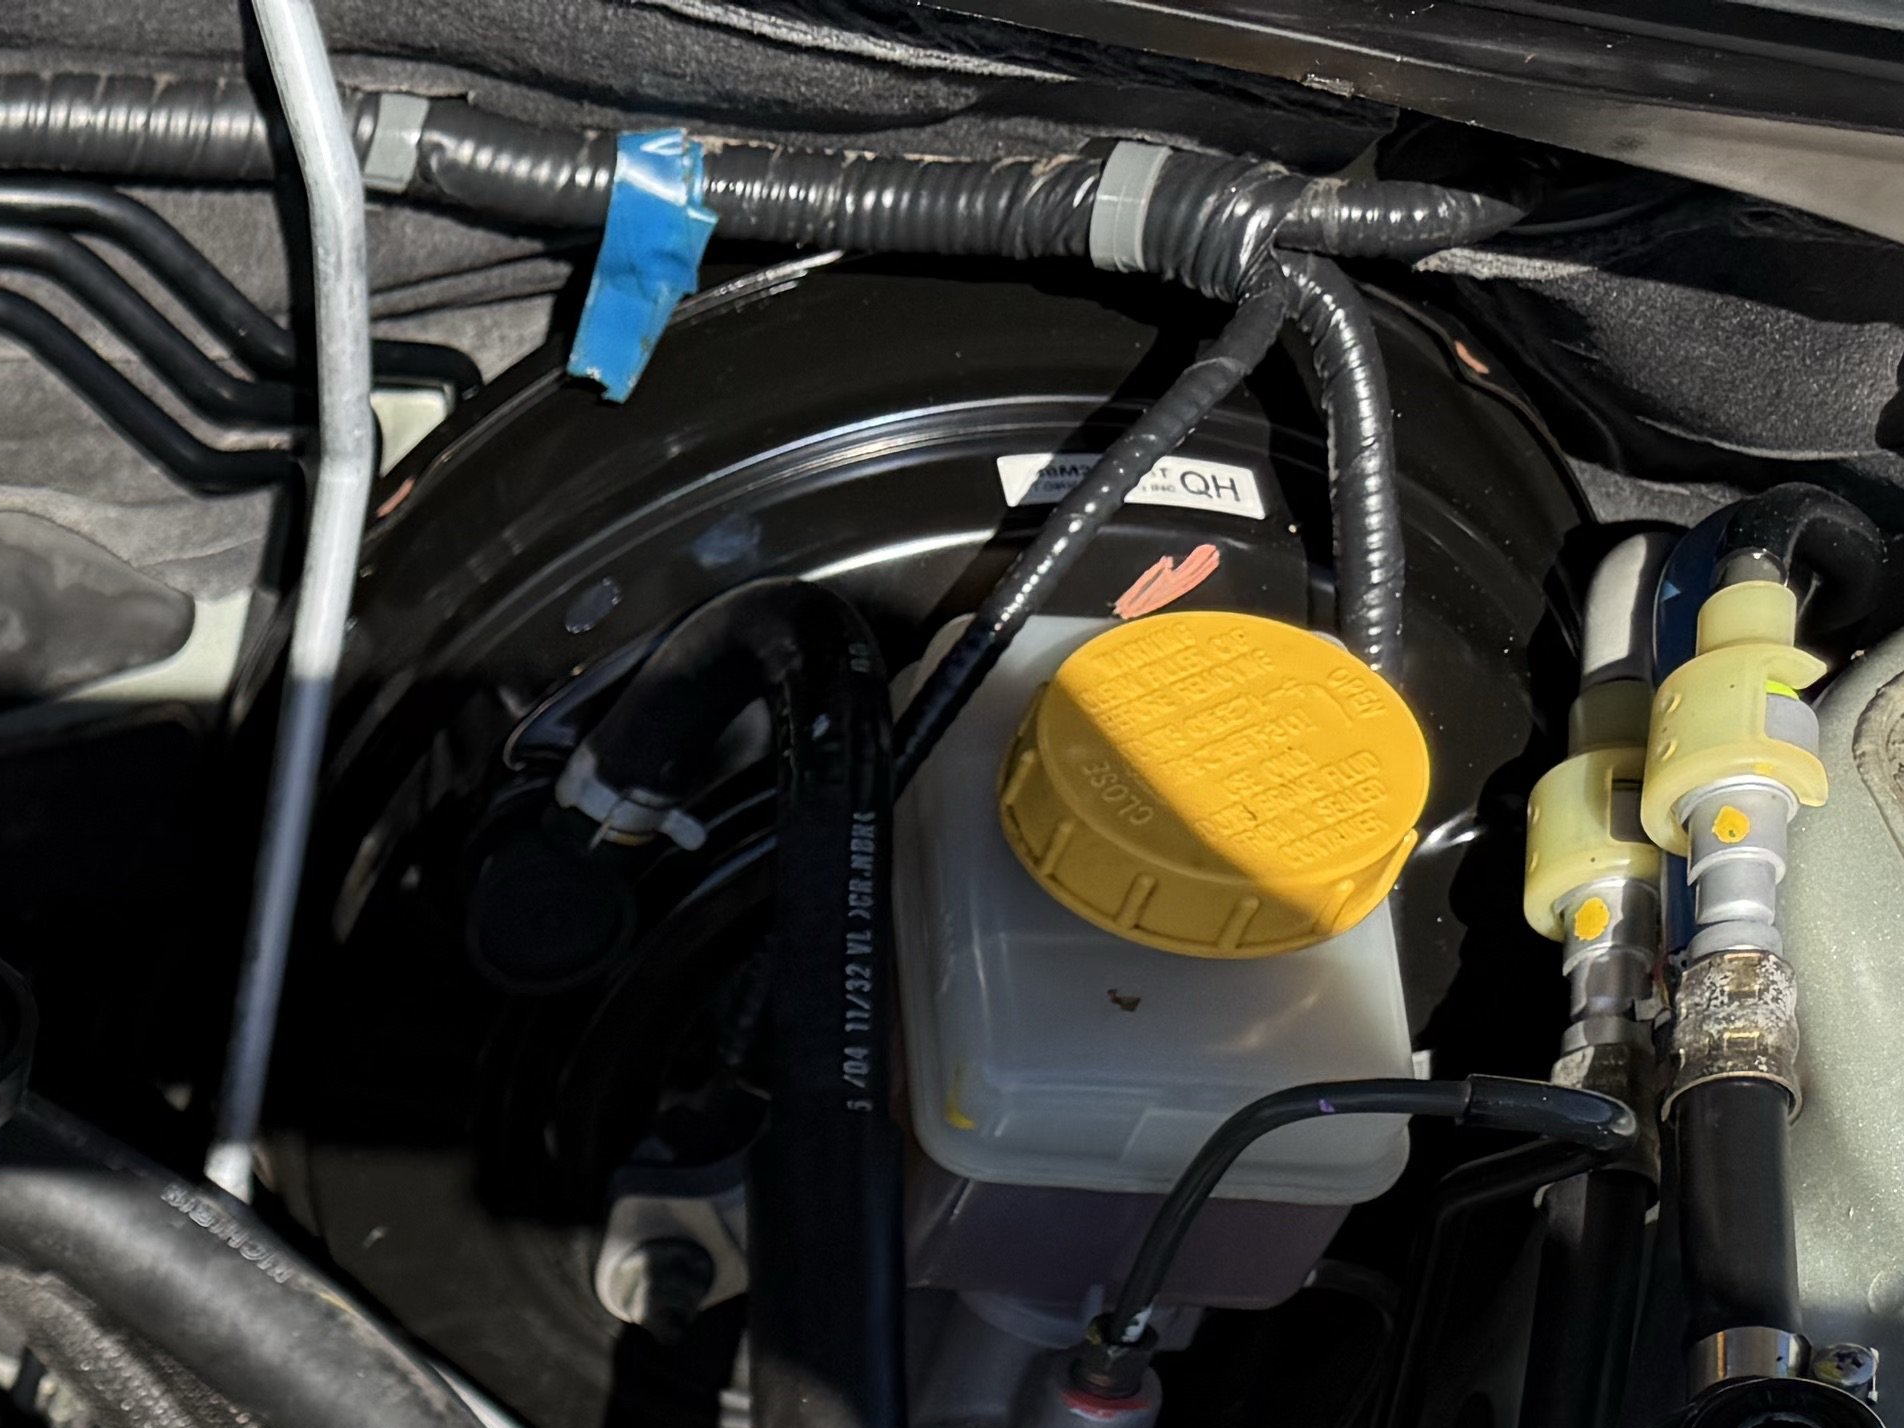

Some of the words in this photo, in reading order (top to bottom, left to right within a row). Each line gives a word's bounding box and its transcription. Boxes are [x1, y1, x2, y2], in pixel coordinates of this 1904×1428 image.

[1180, 470, 1241, 503] QH
[1326, 667, 1387, 720] OPEN
[1081, 759, 1156, 828] CLOSE
